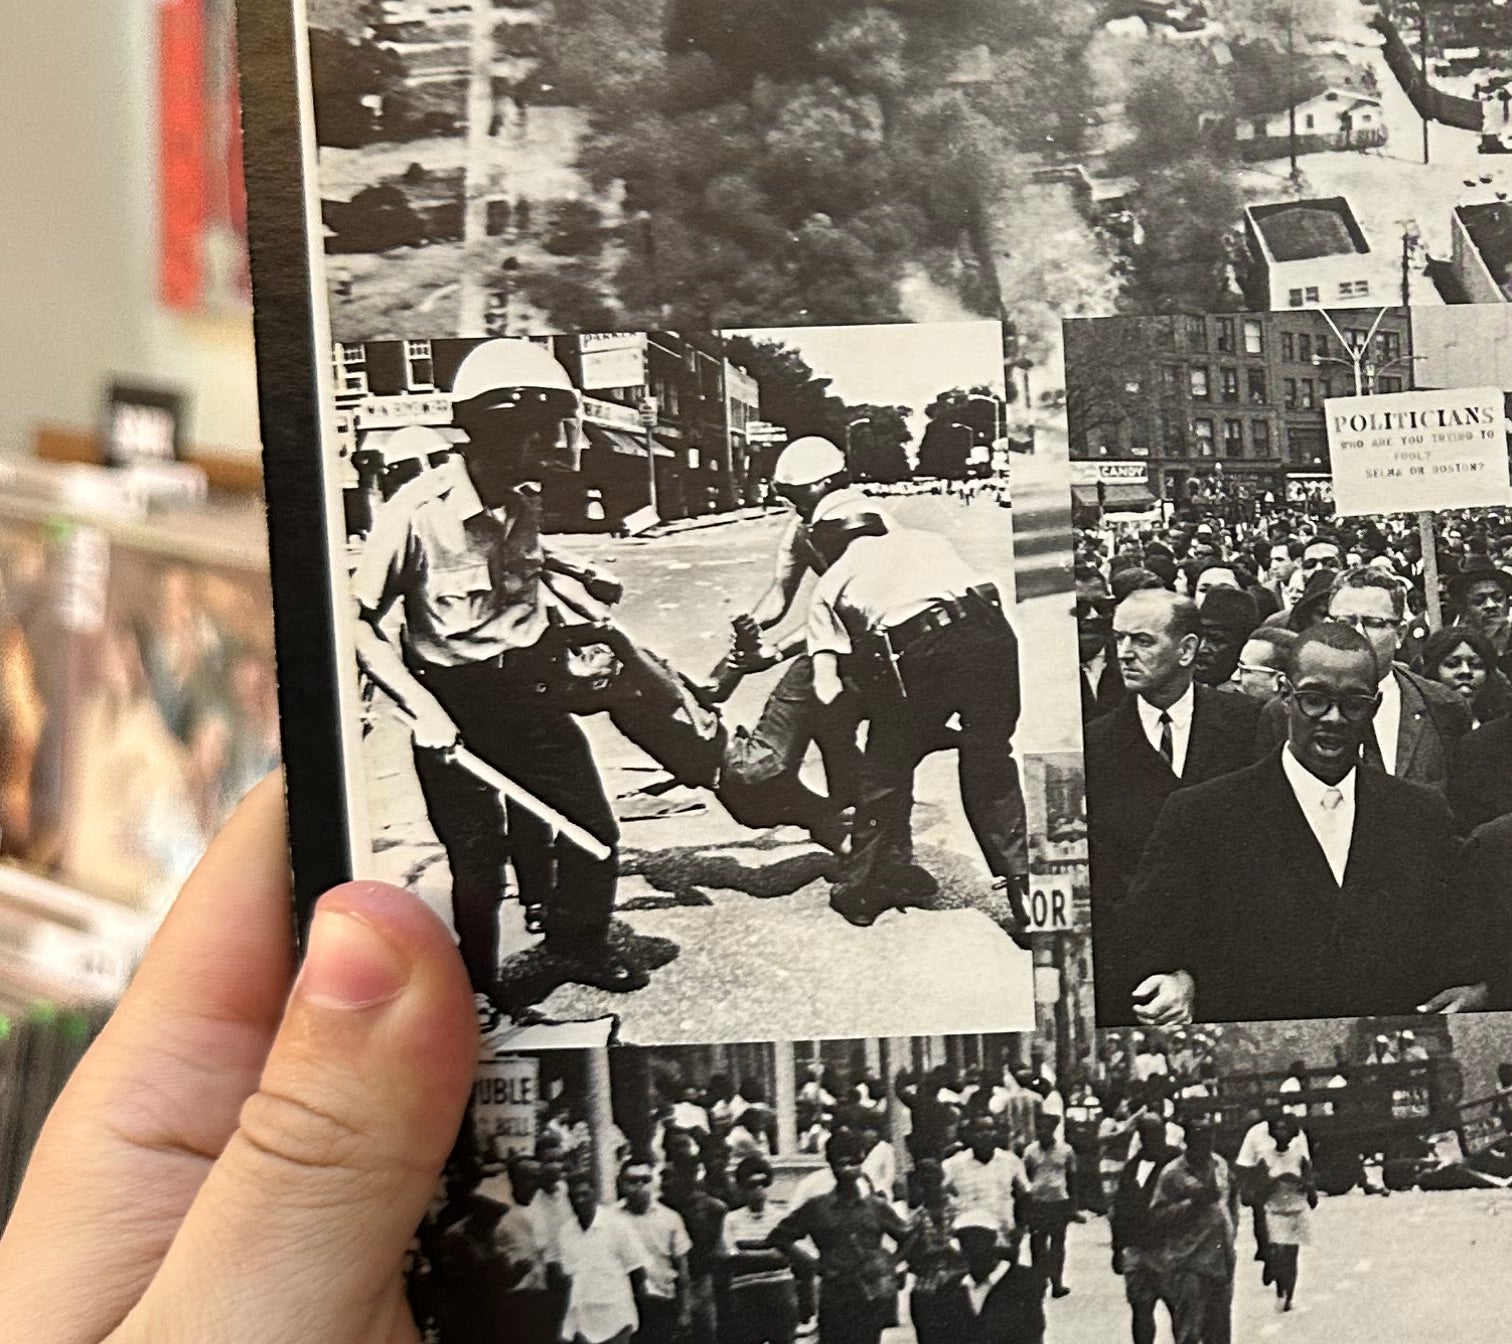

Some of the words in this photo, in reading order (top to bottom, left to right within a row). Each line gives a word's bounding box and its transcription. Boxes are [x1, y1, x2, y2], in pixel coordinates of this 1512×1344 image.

[1334, 406, 1495, 433] POLITICIANS
[1371, 437, 1392, 448] ARE
[1401, 435, 1424, 446] YOU
